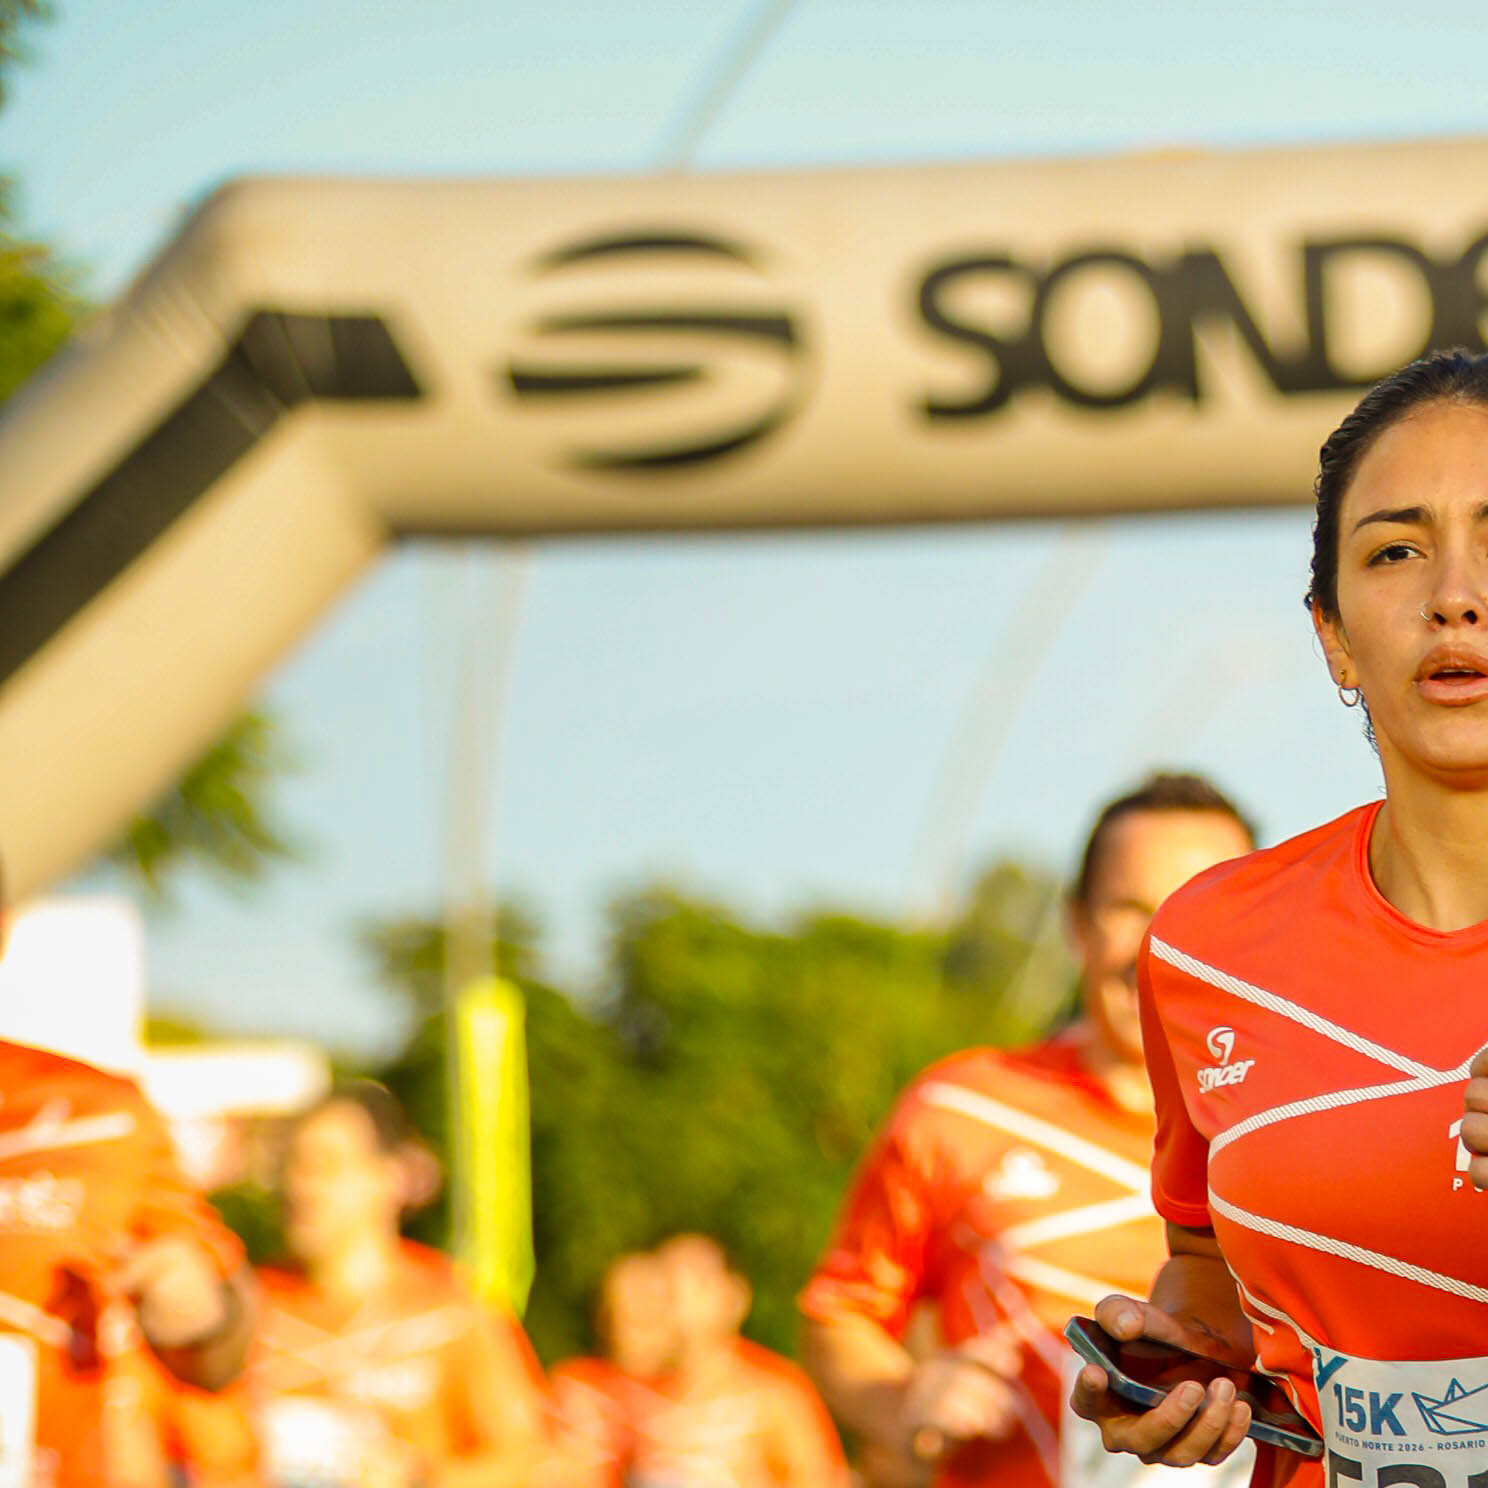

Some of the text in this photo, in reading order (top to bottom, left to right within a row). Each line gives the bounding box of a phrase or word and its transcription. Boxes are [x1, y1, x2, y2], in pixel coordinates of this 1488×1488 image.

[1334, 1383, 1407, 1436] 15K
[1335, 1431, 1360, 1447] PUERTO
[1362, 1440, 1395, 1451] NORTE
[1397, 1443, 1425, 1452] 2026
[1437, 1440, 1485, 1451] ROSARIO
